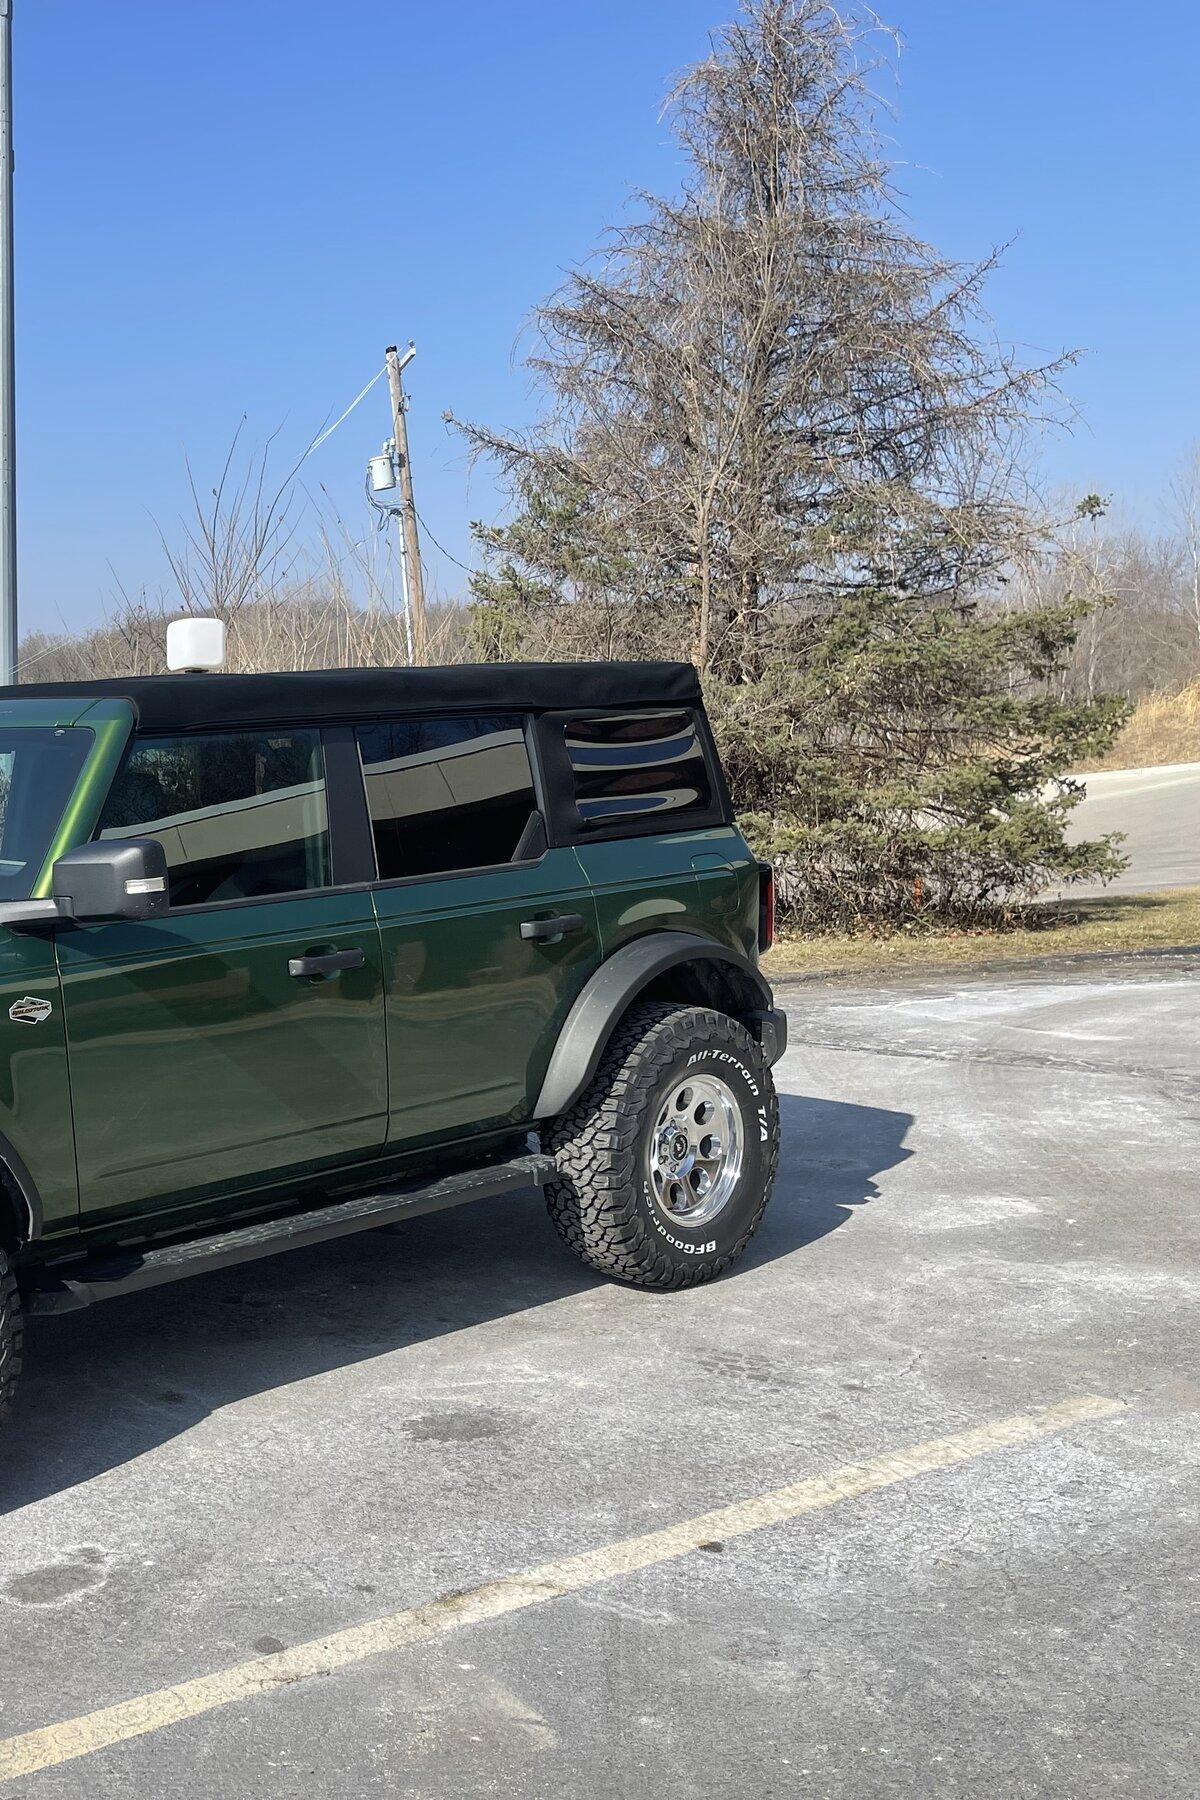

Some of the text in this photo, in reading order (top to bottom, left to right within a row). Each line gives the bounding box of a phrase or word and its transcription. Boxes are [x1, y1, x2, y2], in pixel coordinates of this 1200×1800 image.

[686, 1050, 769, 1142] All-Terrain T/A
[643, 1180, 717, 1255] BFGoodrich
